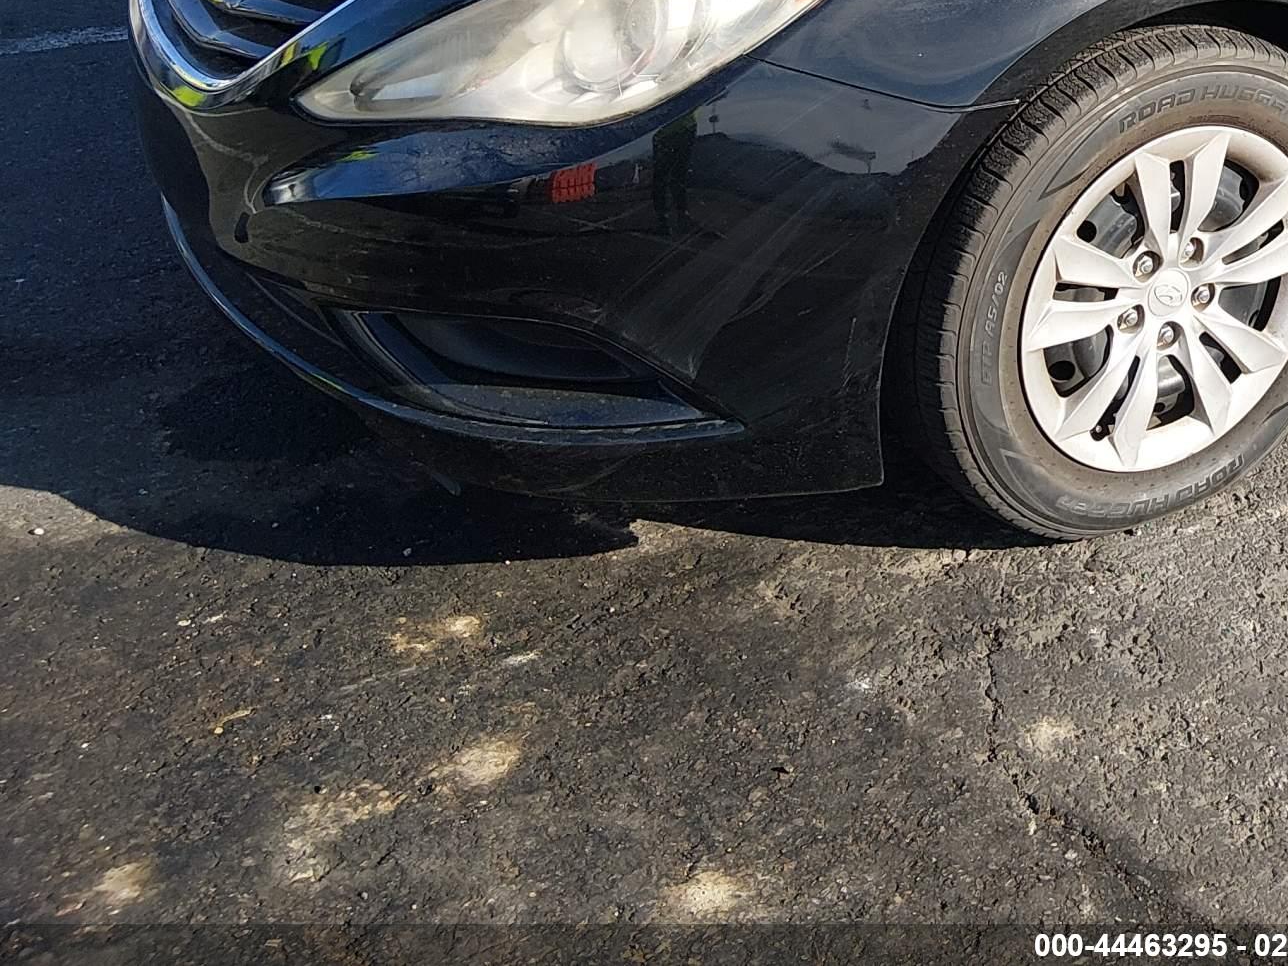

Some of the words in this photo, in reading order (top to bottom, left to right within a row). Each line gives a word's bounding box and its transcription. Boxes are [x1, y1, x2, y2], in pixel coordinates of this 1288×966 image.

[1118, 87, 1197, 135] ROAD
[1175, 452, 1245, 507] ROAD
[1055, 493, 1171, 519] HUGGER
